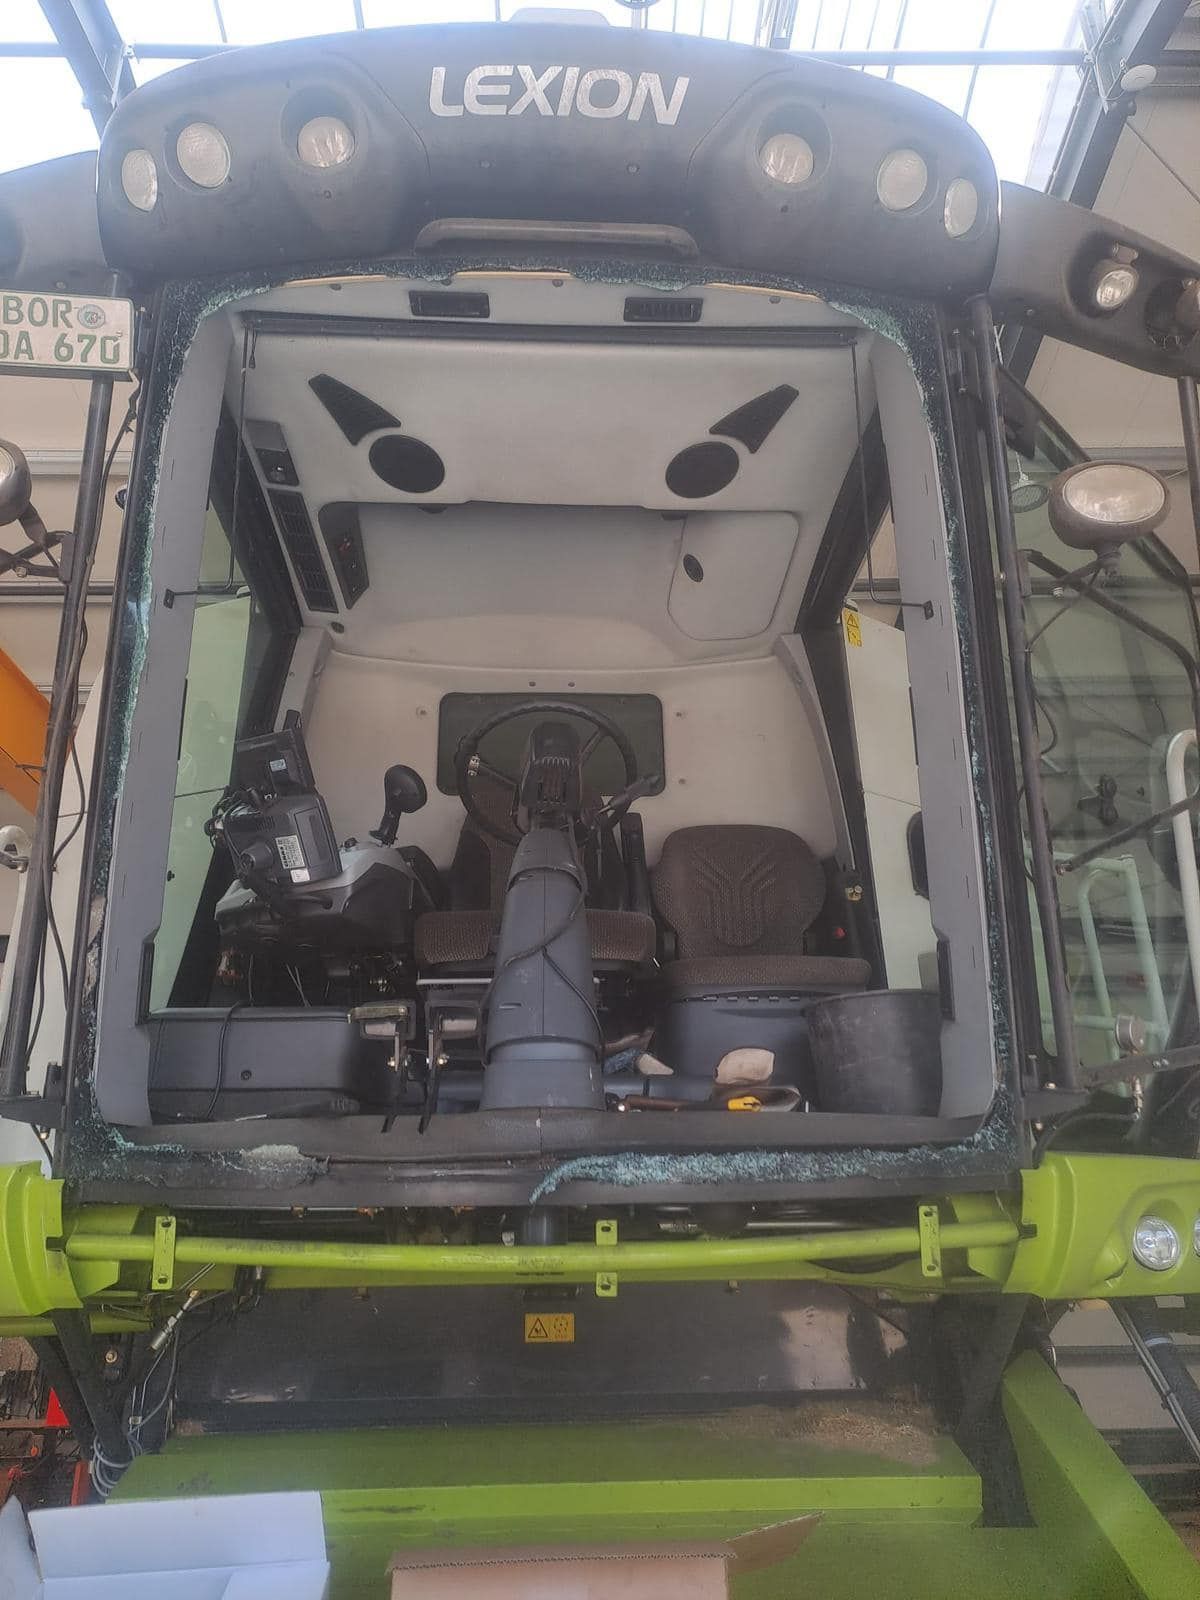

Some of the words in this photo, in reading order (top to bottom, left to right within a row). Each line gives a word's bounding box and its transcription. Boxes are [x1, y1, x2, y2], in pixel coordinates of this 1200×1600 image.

[429, 65, 690, 126] LEXION
[2, 295, 73, 328] BOR
[53, 333, 120, 365] 670
